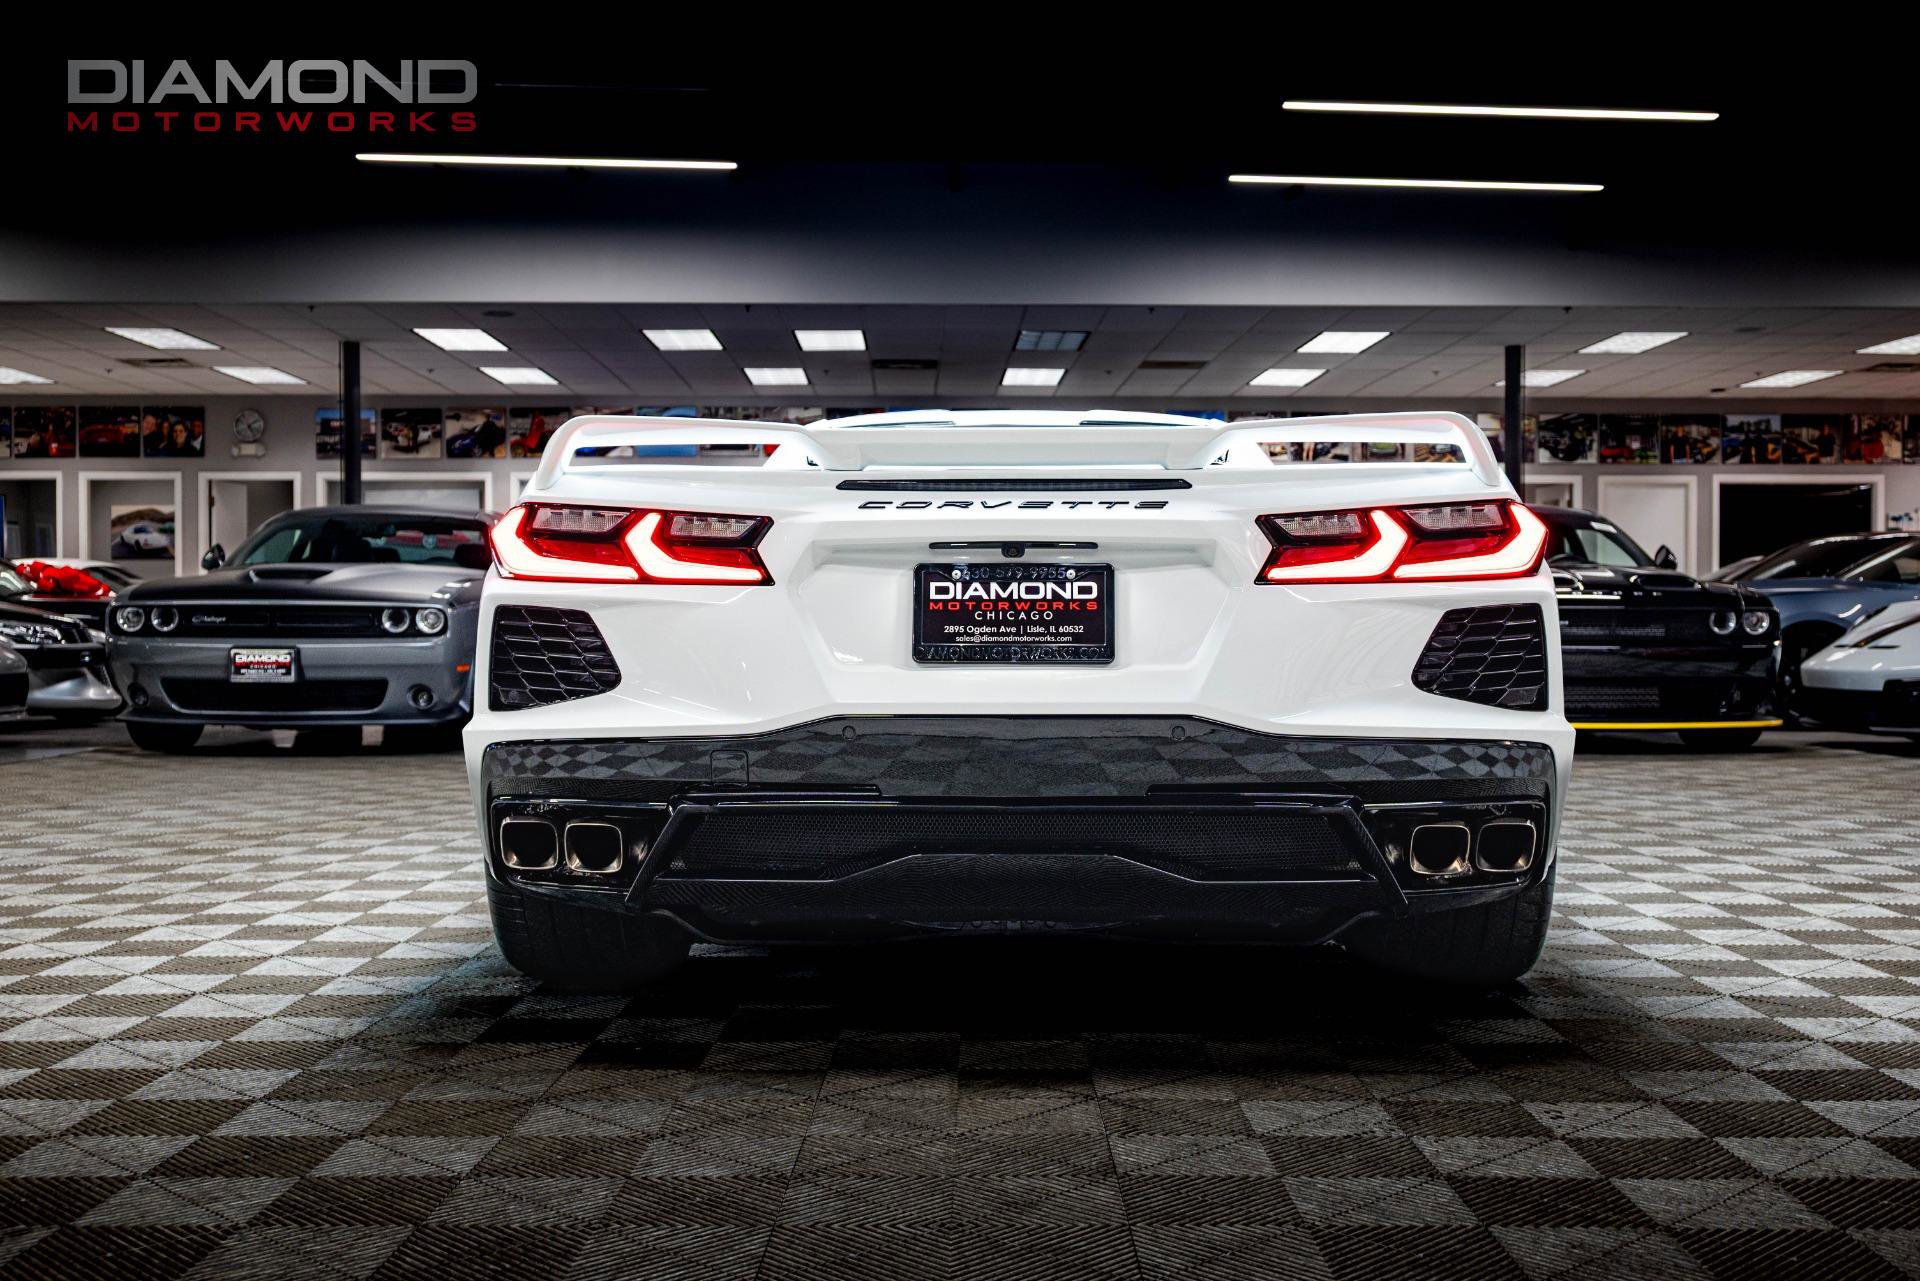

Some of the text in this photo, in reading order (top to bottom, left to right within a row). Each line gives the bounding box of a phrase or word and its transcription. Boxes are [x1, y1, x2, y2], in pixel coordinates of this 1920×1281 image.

[858, 501, 1169, 509] CORVETTE
[929, 581, 1098, 600] DIAMOND
[929, 601, 1098, 610] MOTORWORKS
[974, 611, 1053, 620] CHICAGO
[943, 625, 965, 633] 2895
[966, 625, 997, 635] Ogden
[999, 625, 1017, 633] Ave
[1027, 625, 1047, 634] Lisle,
[1049, 625, 1057, 633] IL
[1058, 625, 1084, 633] 60532
[955, 634, 1073, 643] sales@diamondmotorworks.com
